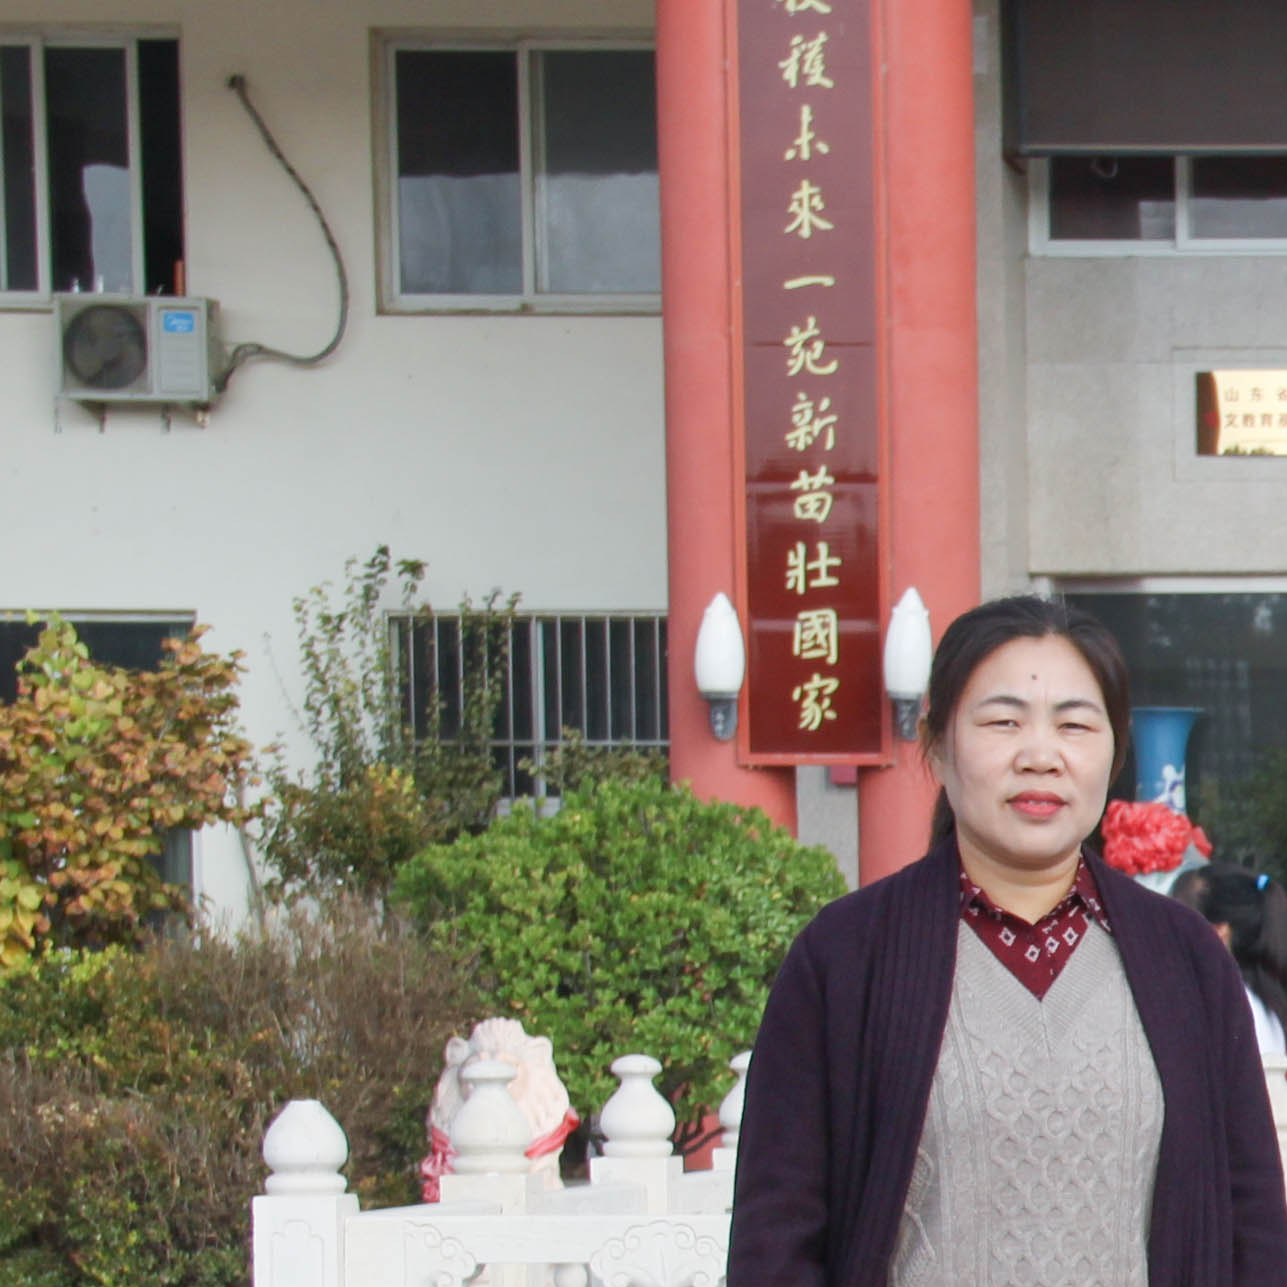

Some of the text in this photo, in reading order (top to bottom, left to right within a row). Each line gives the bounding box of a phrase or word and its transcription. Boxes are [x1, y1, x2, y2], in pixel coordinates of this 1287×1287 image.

[779, 0, 841, 730] 穫未來一苑新苗壯國家
